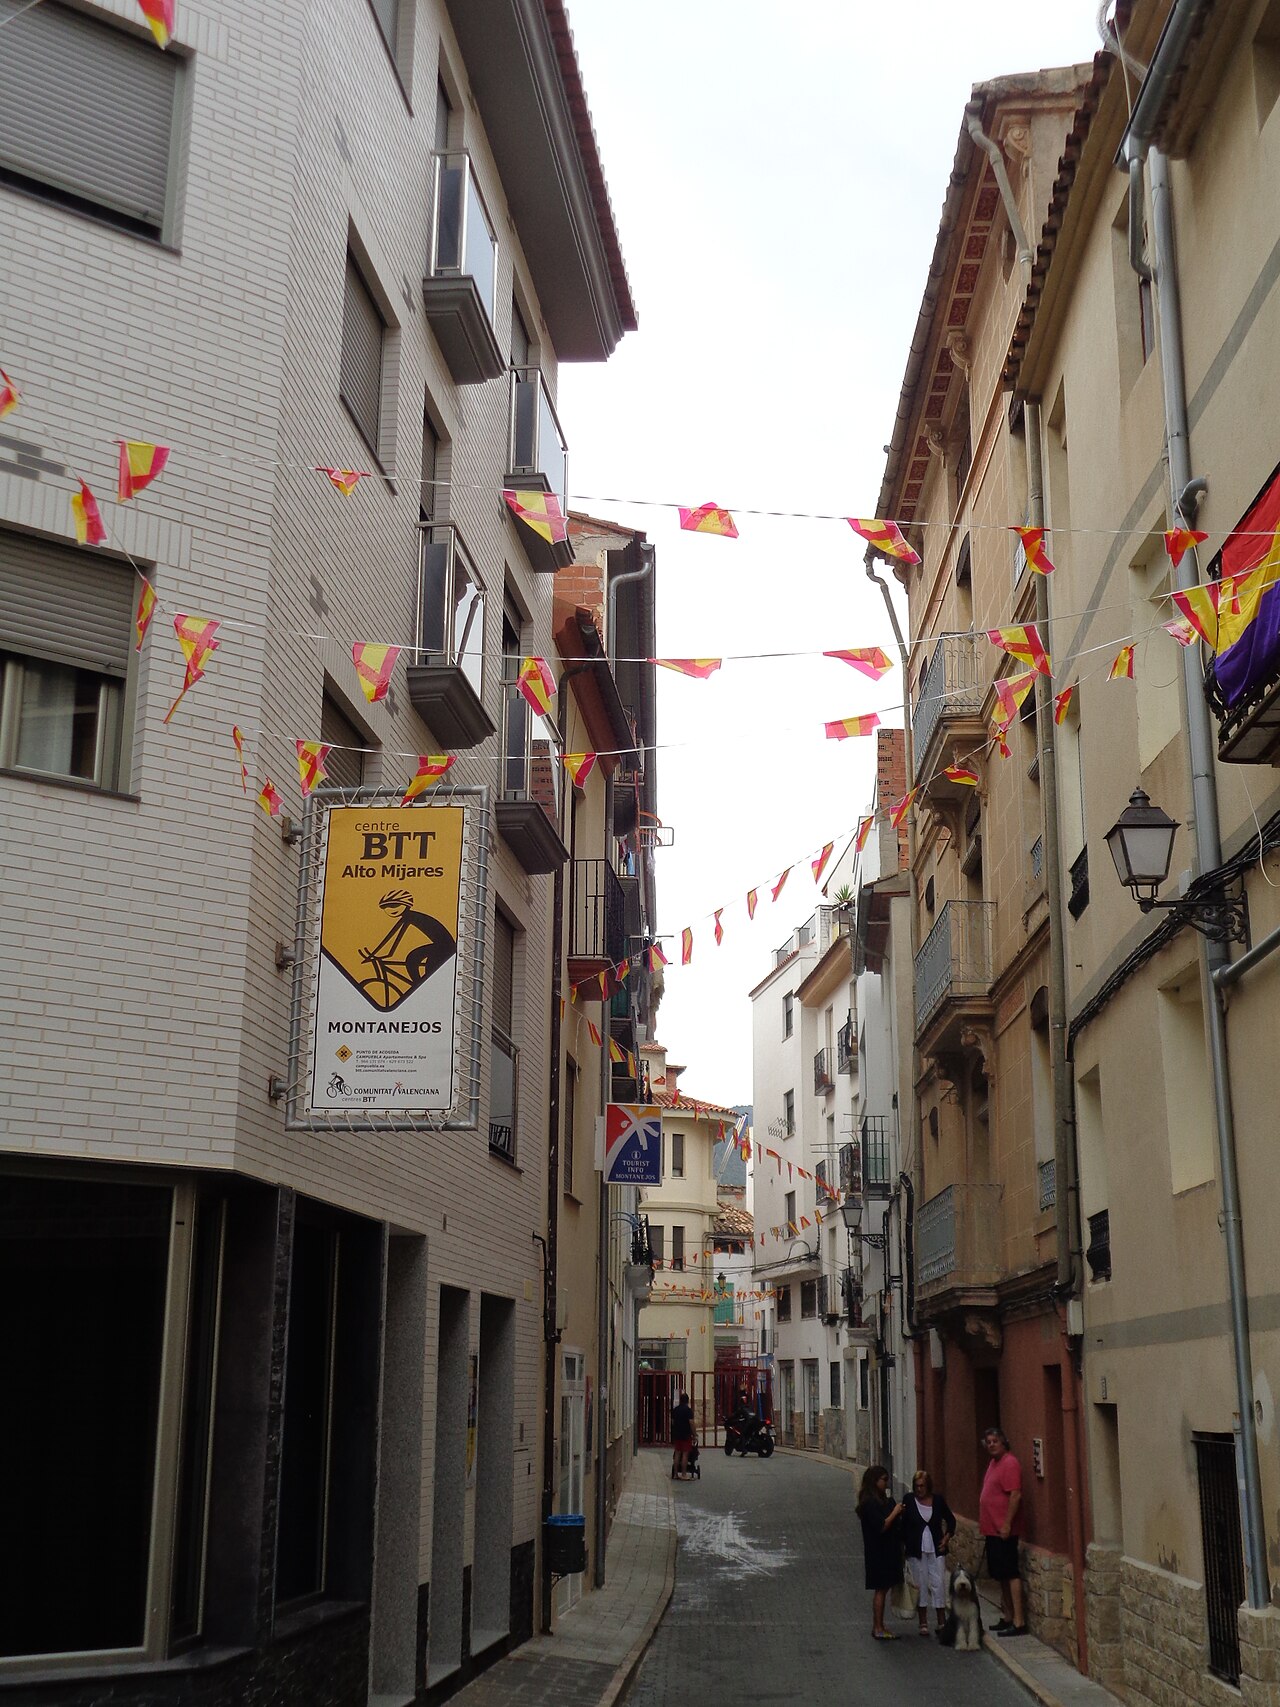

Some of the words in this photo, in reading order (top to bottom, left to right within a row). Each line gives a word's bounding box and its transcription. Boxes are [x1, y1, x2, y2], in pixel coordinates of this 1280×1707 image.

[355, 821, 400, 831] centre
[360, 831, 436, 860] BTT
[341, 865, 376, 878] Alto
[381, 864, 444, 880] Mijares
[328, 1021, 442, 1033] MONTANEJOS
